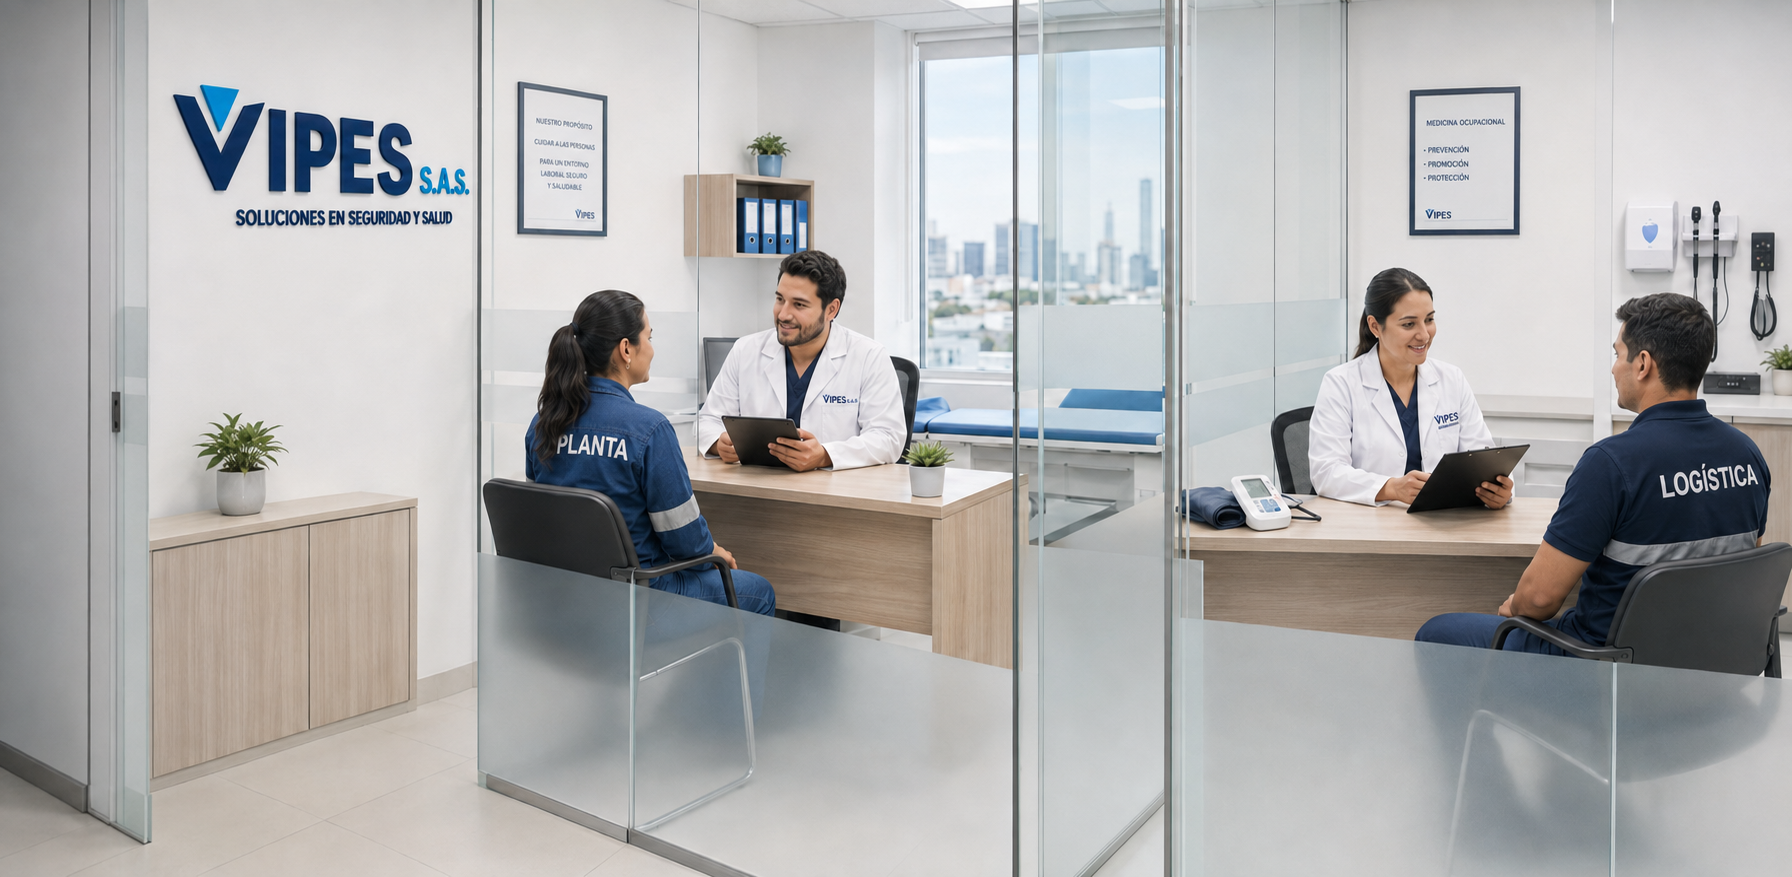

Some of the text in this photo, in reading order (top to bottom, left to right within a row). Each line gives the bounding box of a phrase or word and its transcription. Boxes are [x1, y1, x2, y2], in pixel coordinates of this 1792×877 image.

[536, 118, 593, 130] NUESTRO PROPÓSITO
[173, 94, 470, 196] VIPES S.A.S.
[534, 138, 554, 146] CUIDAR
[1428, 145, 1469, 153] PREVENCIÓN
[1428, 159, 1469, 168] PROMOCIÓN
[1428, 173, 1469, 181] PROTECCIÓN
[236, 209, 452, 226] SOLUCIONES EN SEGURIDAD Y SALUD
[575, 209, 595, 219] VIPES
[1425, 209, 1452, 219] VIPES
[823, 395, 846, 403] VIPES
[1434, 412, 1459, 424] VIPES
[557, 434, 628, 461] PLANTA
[1660, 464, 1759, 498] LOGÍSTICA
